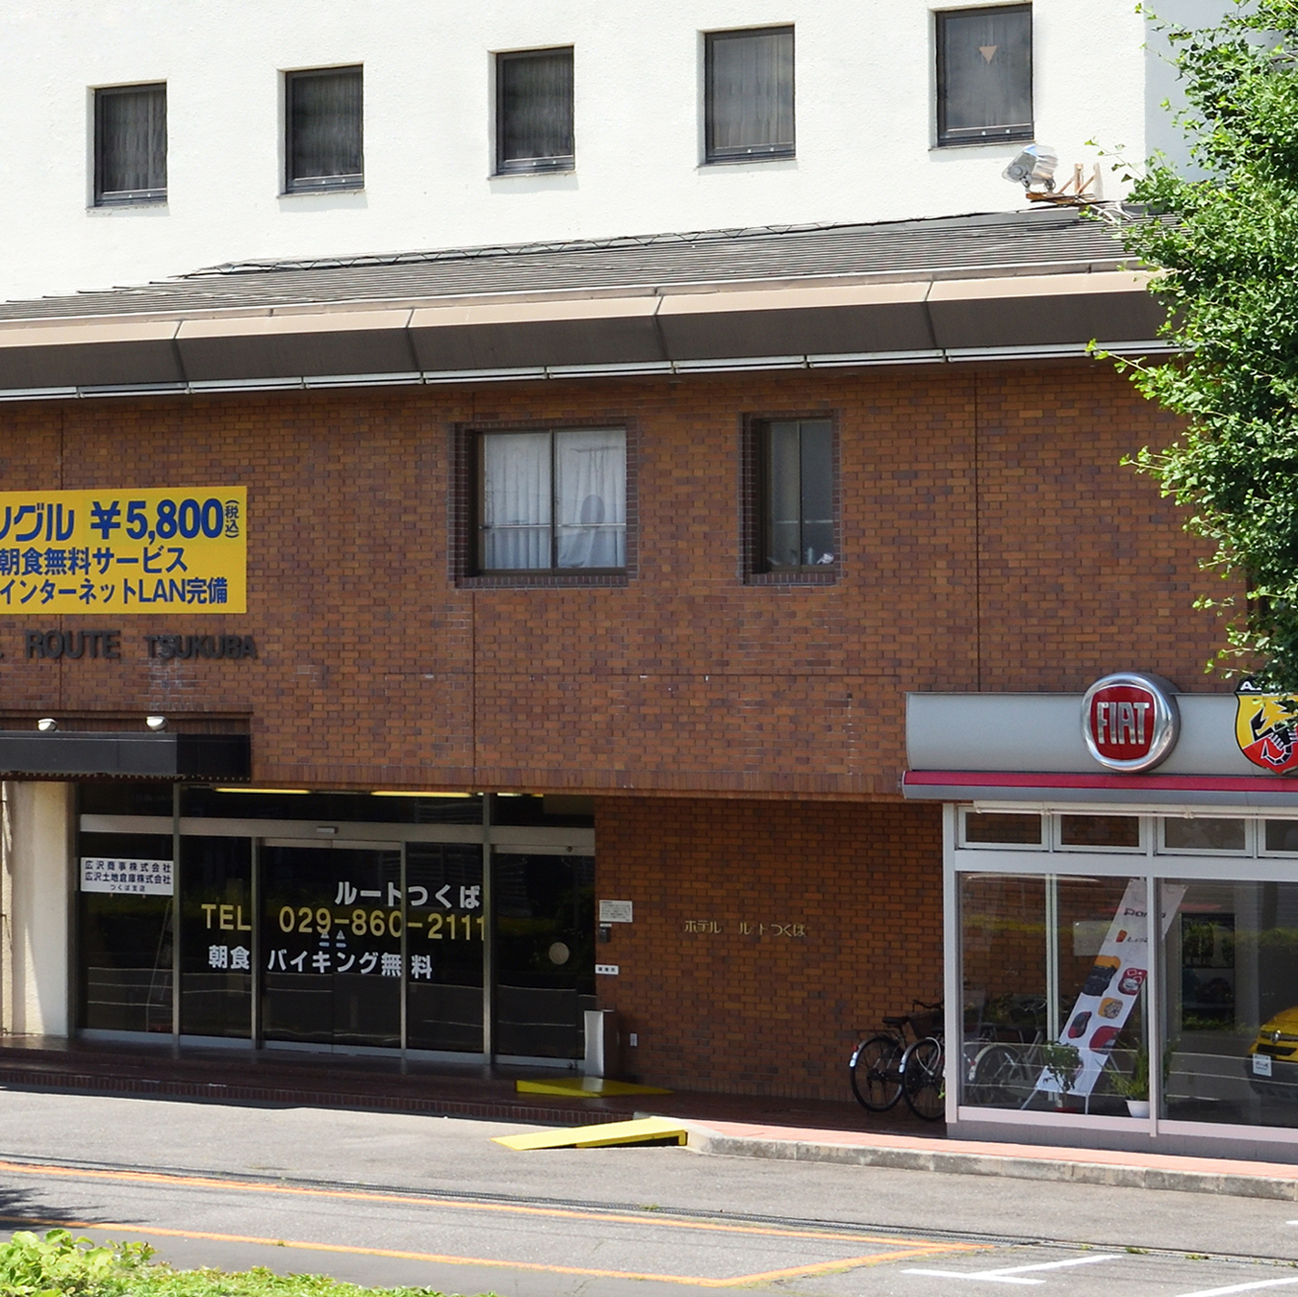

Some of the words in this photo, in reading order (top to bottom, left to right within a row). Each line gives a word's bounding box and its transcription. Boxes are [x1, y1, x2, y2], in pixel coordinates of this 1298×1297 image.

[24, 629, 121, 660] ROUTE
[143, 634, 258, 660] TSUKUBA
[1097, 702, 1150, 744] FIAT
[85, 860, 171, 873] 広沢商事株式会社
[334, 881, 480, 909] ルートつくば
[201, 904, 251, 931] TEL
[279, 905, 486, 941] 029-860-2111
